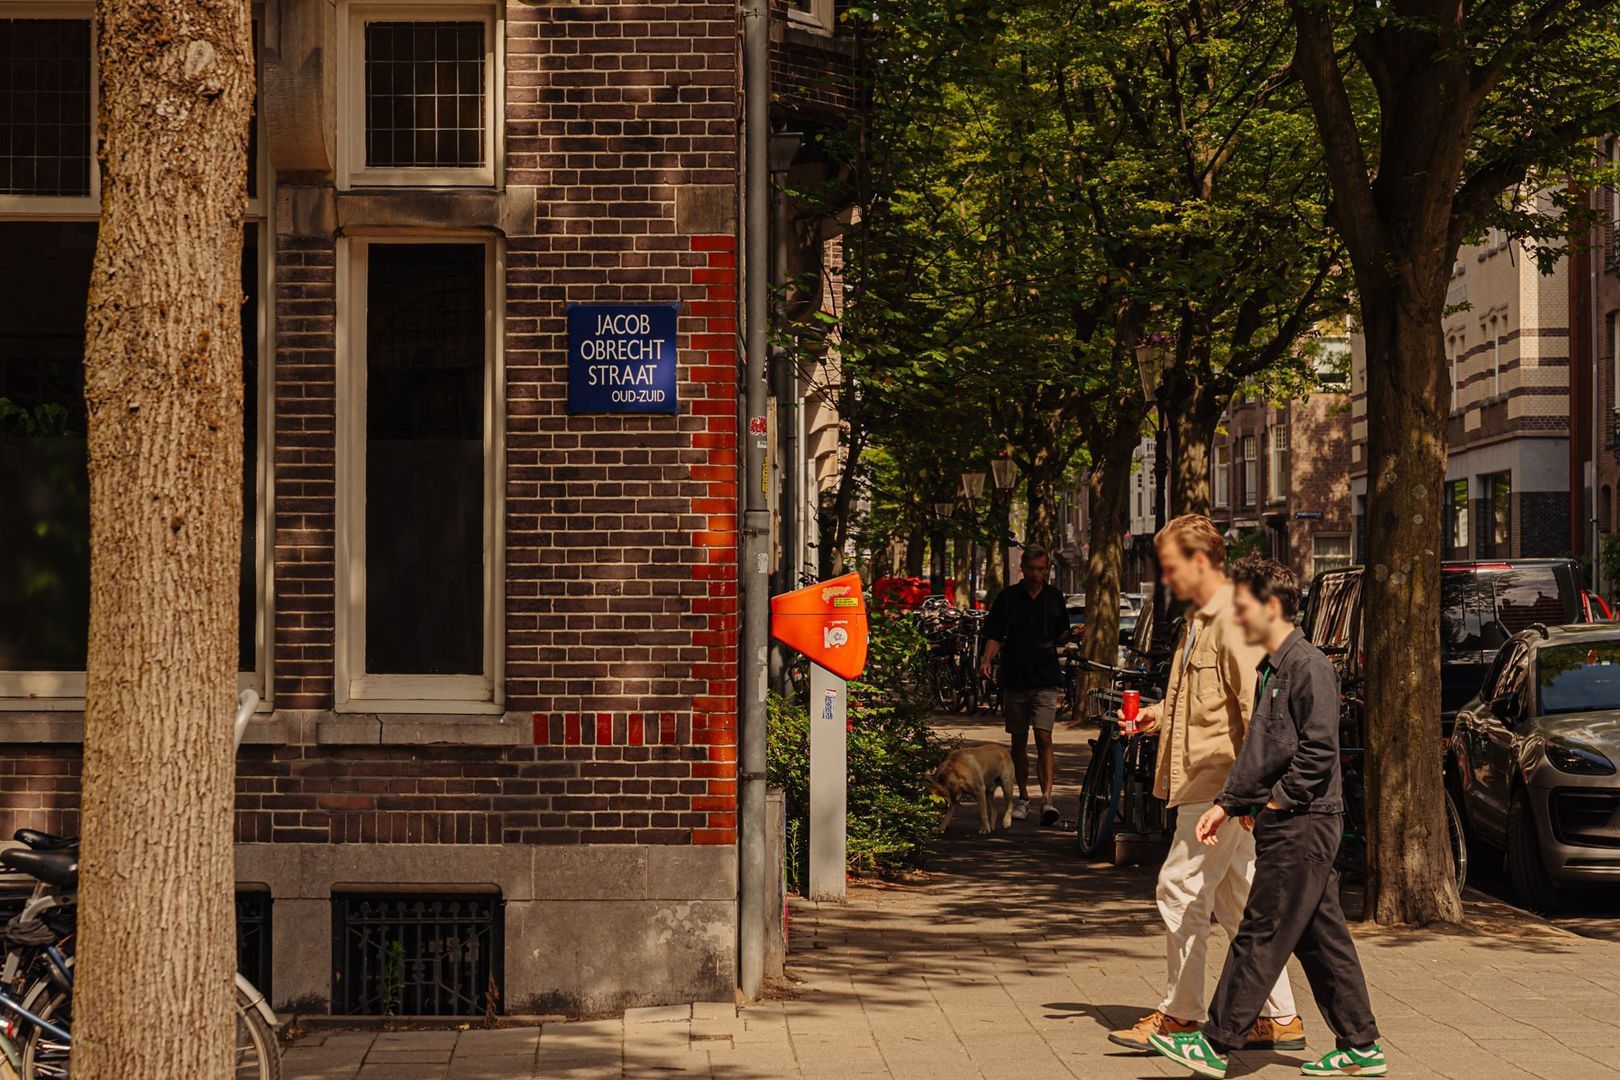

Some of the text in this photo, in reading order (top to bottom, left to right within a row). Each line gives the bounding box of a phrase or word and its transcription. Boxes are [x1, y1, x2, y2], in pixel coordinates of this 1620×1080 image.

[595, 314, 651, 336] JACOB
[580, 339, 665, 360] OBRECHT
[588, 364, 657, 386] STRAAT
[611, 389, 665, 402] OUD-ZUID
